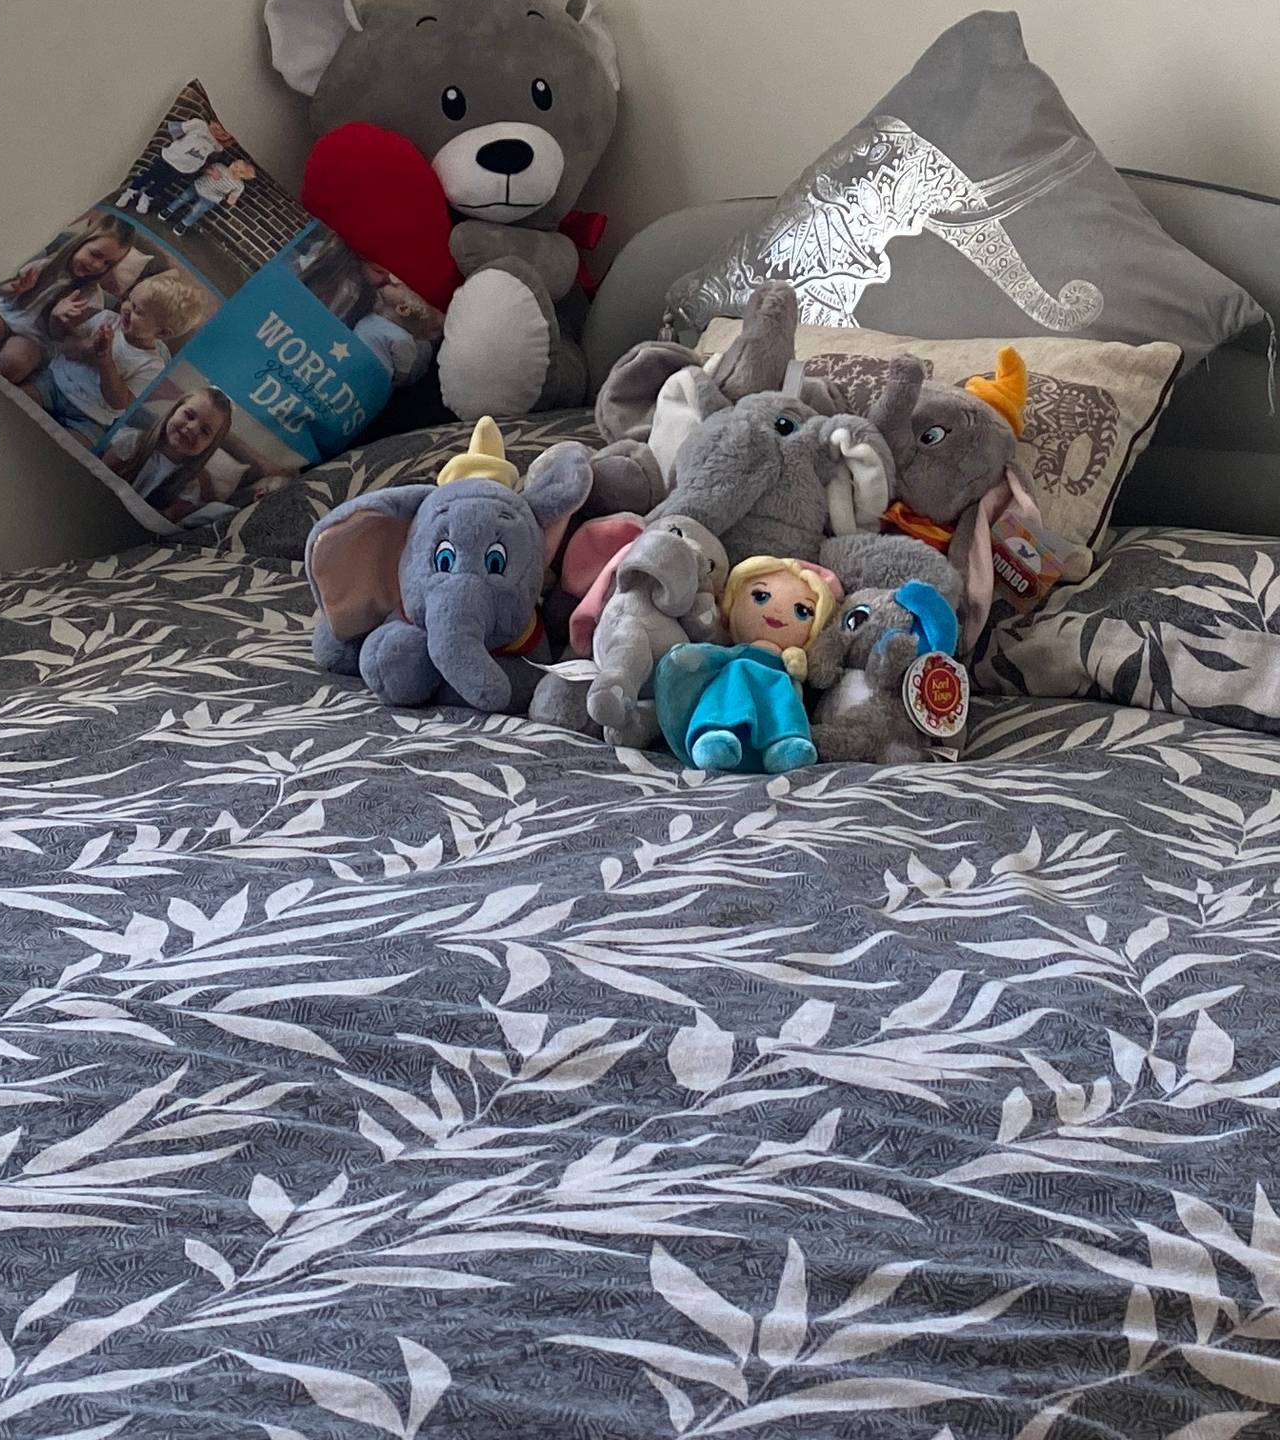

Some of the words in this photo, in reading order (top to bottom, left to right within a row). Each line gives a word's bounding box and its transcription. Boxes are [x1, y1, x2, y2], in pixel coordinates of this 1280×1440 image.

[256, 310, 366, 436] WORLD'S
[249, 374, 316, 433] DAD
[931, 677, 950, 689] Keel
[931, 690, 952, 702] Toys
